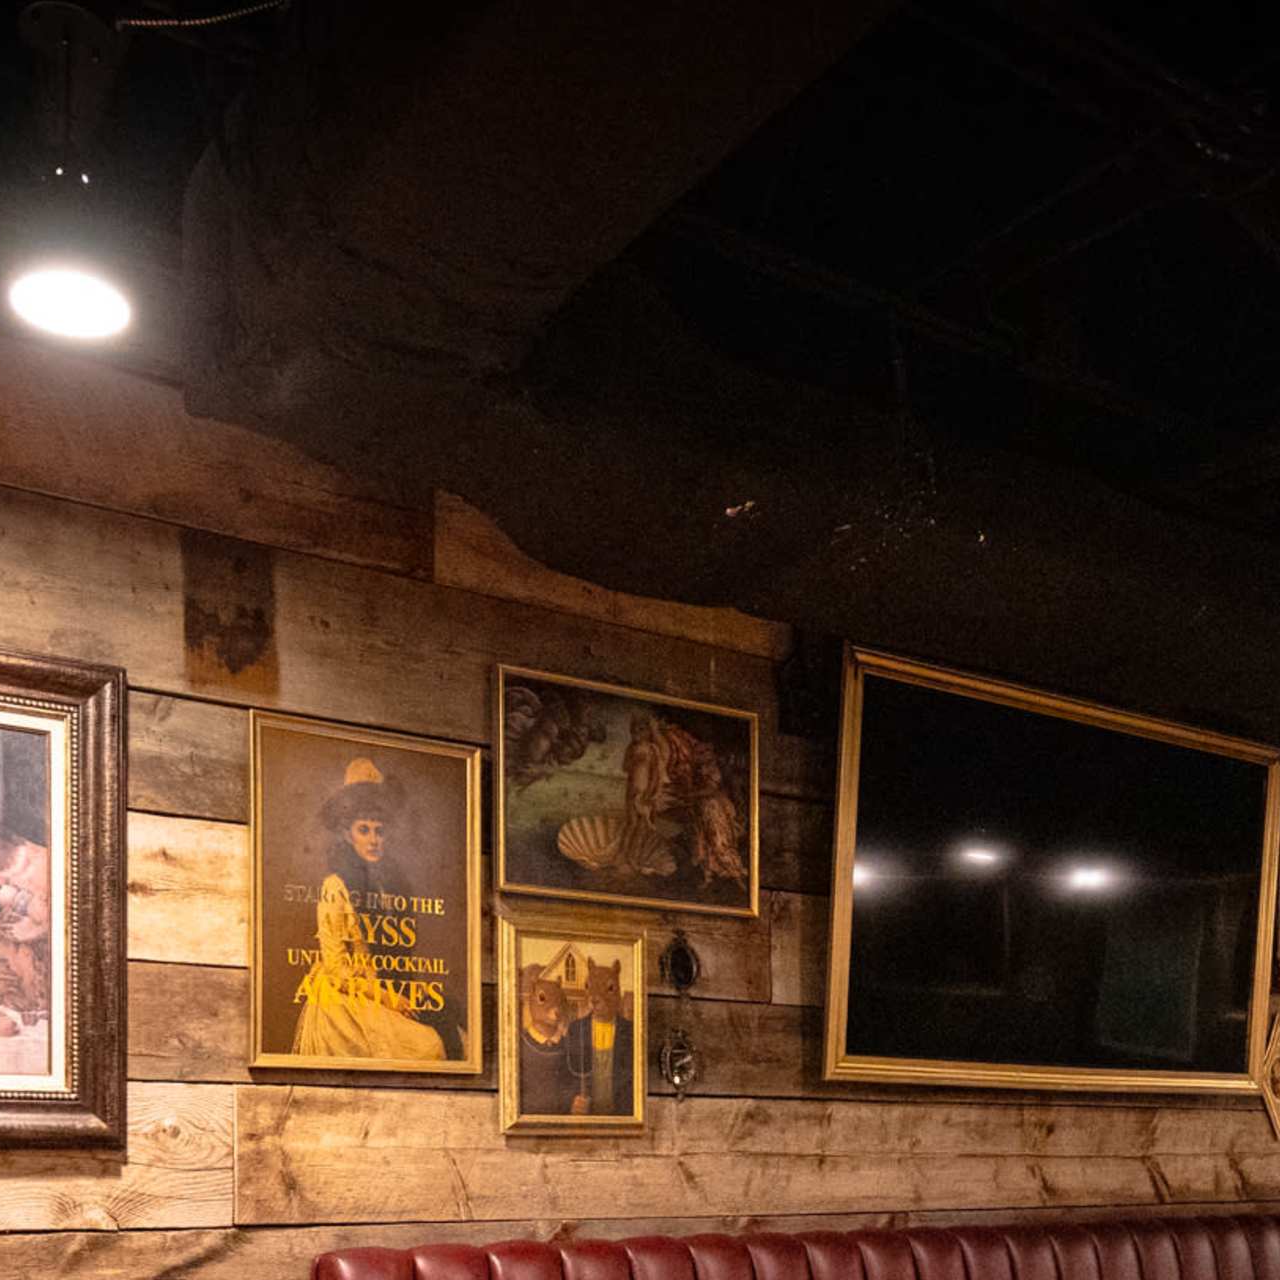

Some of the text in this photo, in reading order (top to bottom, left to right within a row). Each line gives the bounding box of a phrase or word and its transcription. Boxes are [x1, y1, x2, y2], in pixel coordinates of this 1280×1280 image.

[367, 890, 407, 912] INTO
[409, 896, 445, 916] THE
[371, 953, 449, 976] COCKTAIL
[293, 974, 445, 1012] ARRIVES
